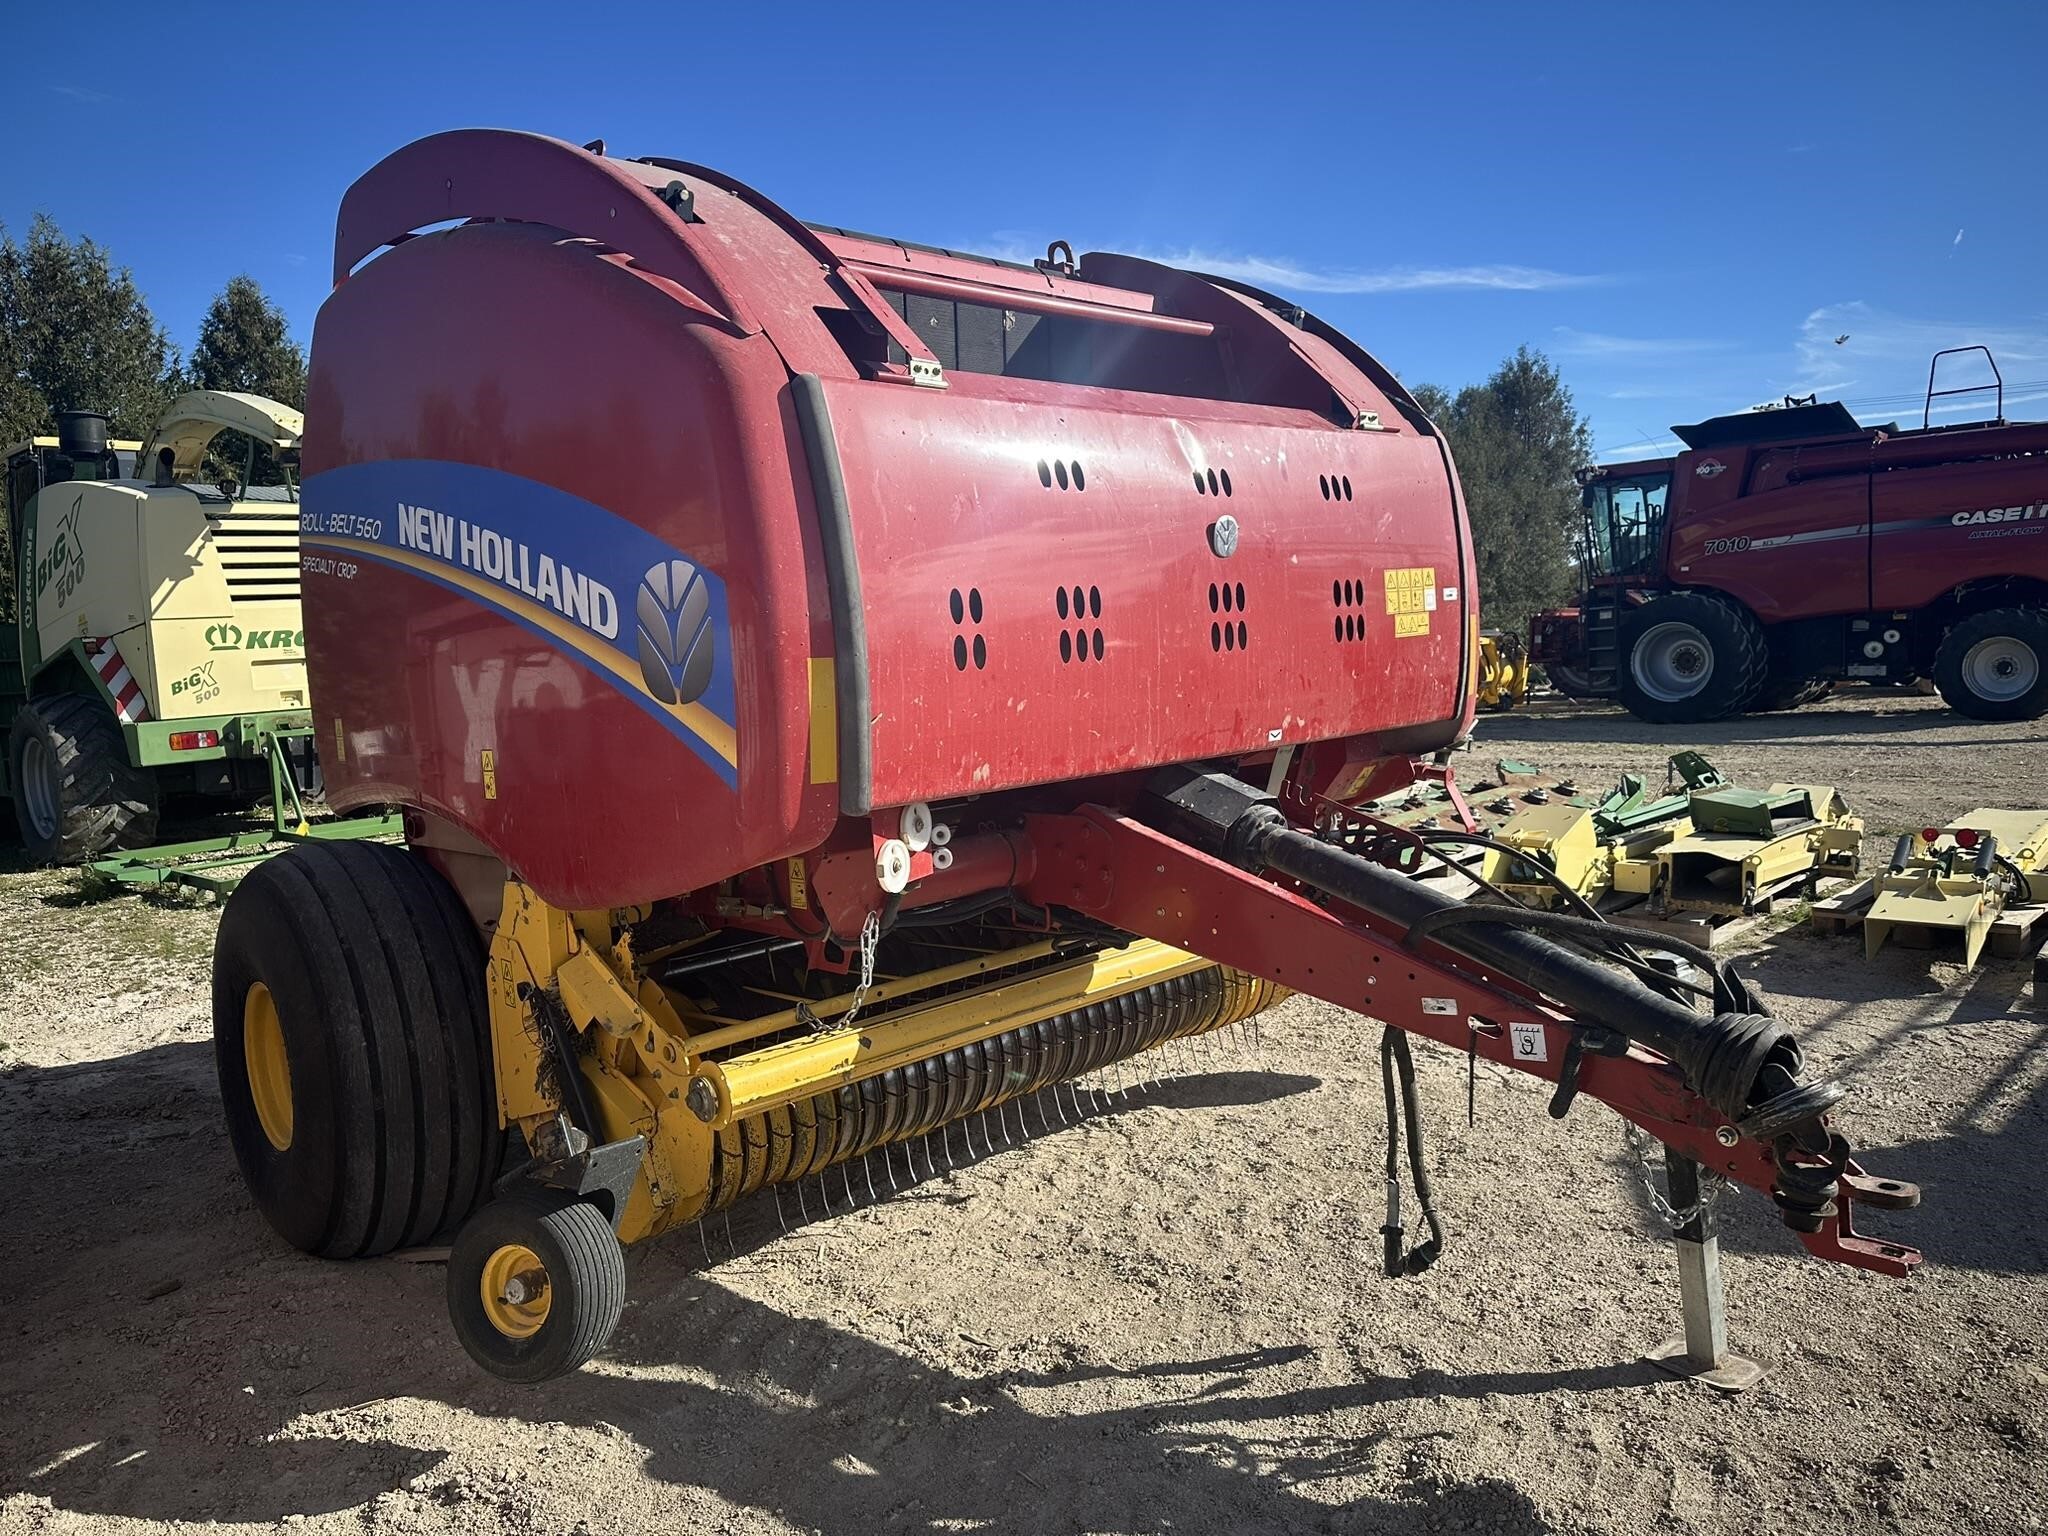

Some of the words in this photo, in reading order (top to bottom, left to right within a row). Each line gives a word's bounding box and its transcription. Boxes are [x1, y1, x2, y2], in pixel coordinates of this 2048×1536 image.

[1951, 506, 2022, 526] CASE
[355, 517, 381, 540] 560
[1704, 535, 1751, 555] 7010
[302, 556, 336, 575] SPECIALTY
[337, 561, 357, 579] CROP
[398, 503, 454, 560] NEW
[459, 519, 619, 640] HOLLAND
[58, 557, 85, 609] 500
[195, 686, 220, 704] 500
